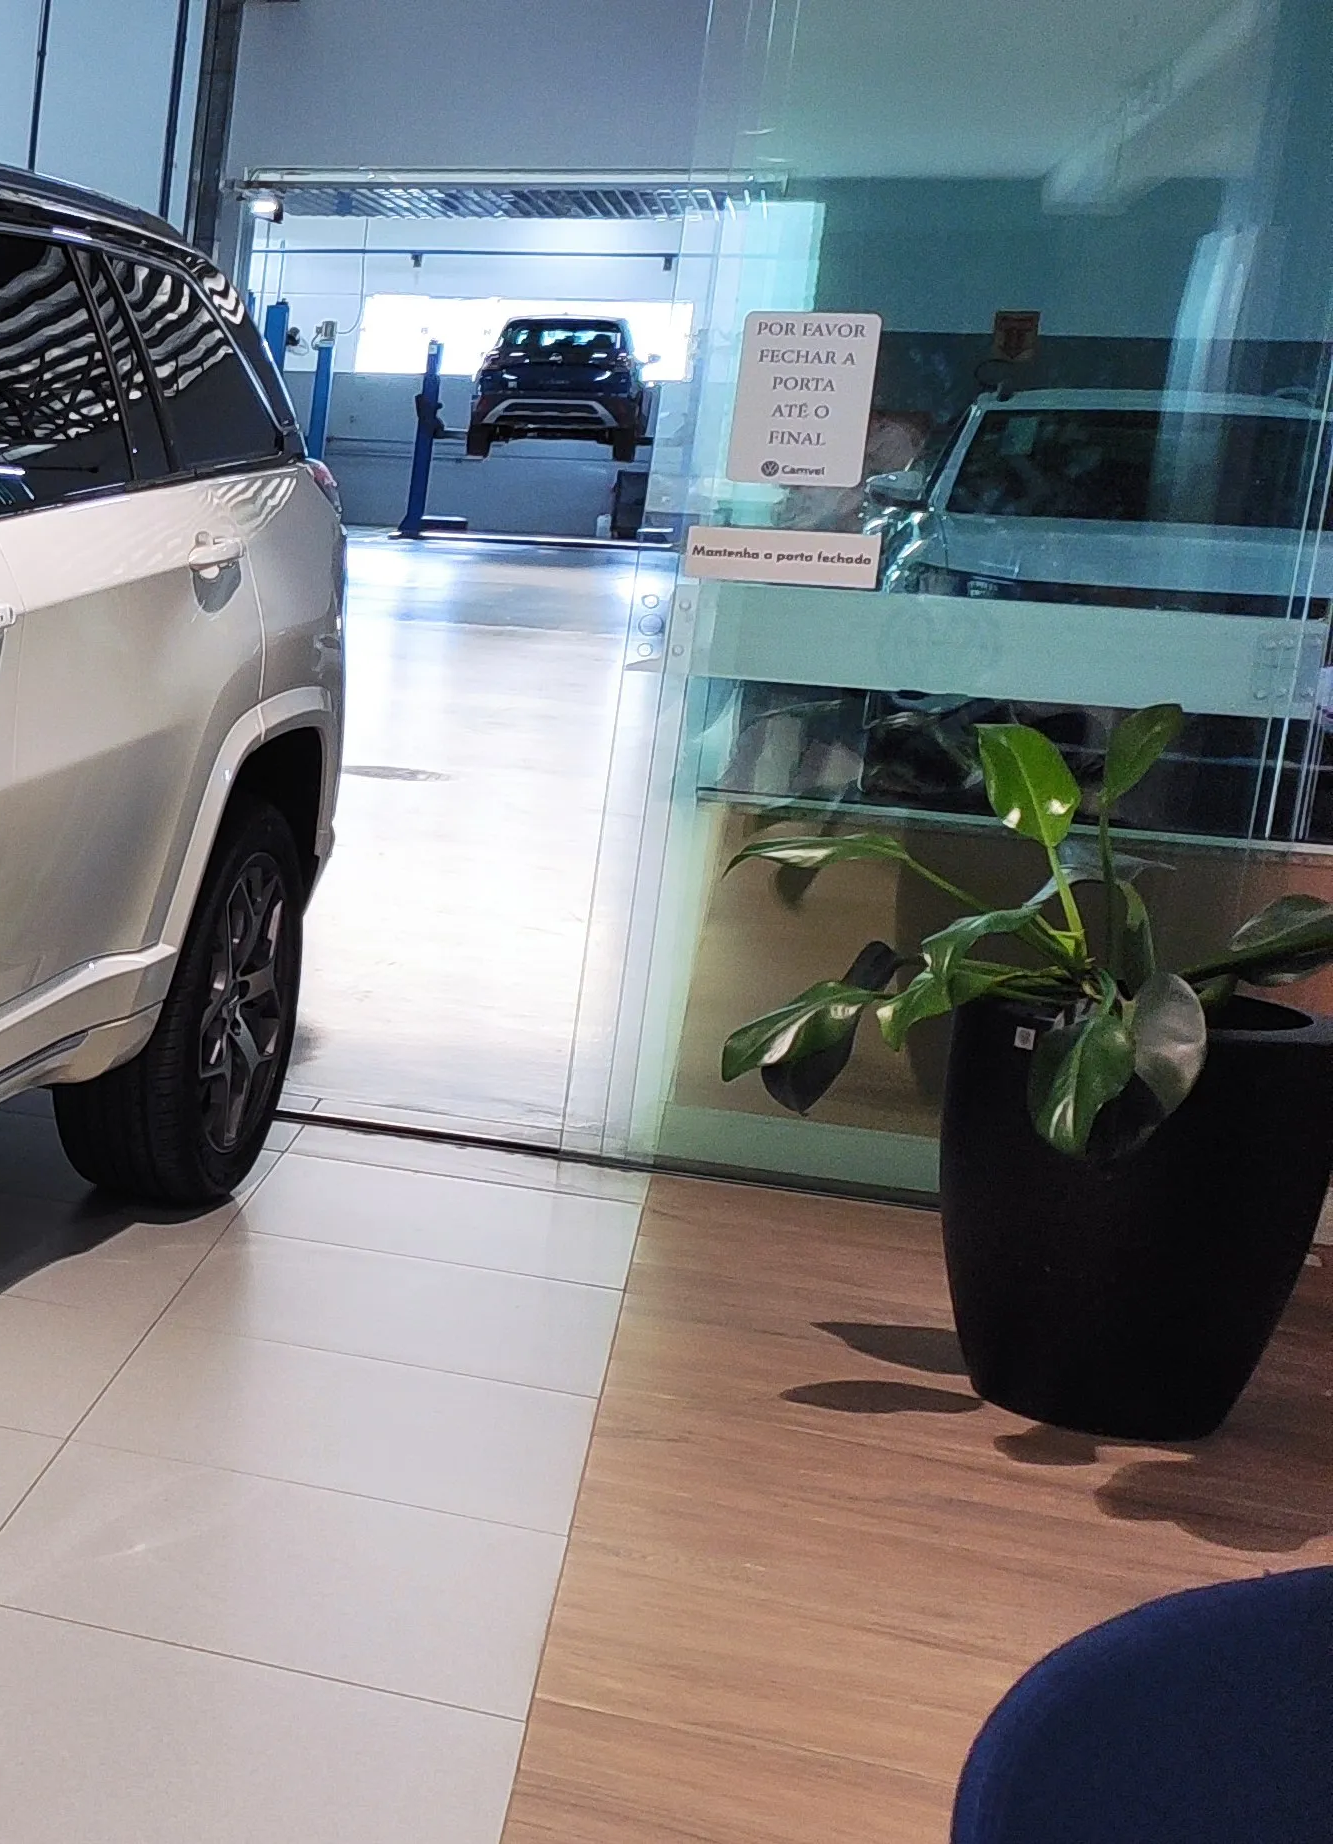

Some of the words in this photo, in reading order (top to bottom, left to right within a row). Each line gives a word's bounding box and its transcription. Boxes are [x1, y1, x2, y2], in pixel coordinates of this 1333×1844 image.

[757, 321, 796, 336] POR
[802, 322, 867, 338] FAVOR
[758, 349, 837, 365] FECHAR
[842, 352, 856, 365] A
[772, 376, 835, 392] PORTA
[771, 402, 810, 418] ATÉ
[814, 405, 830, 419] O
[768, 430, 826, 446] FINAL
[782, 464, 826, 476] Camvel
[691, 544, 760, 560] Mantenha
[776, 551, 813, 563] porta
